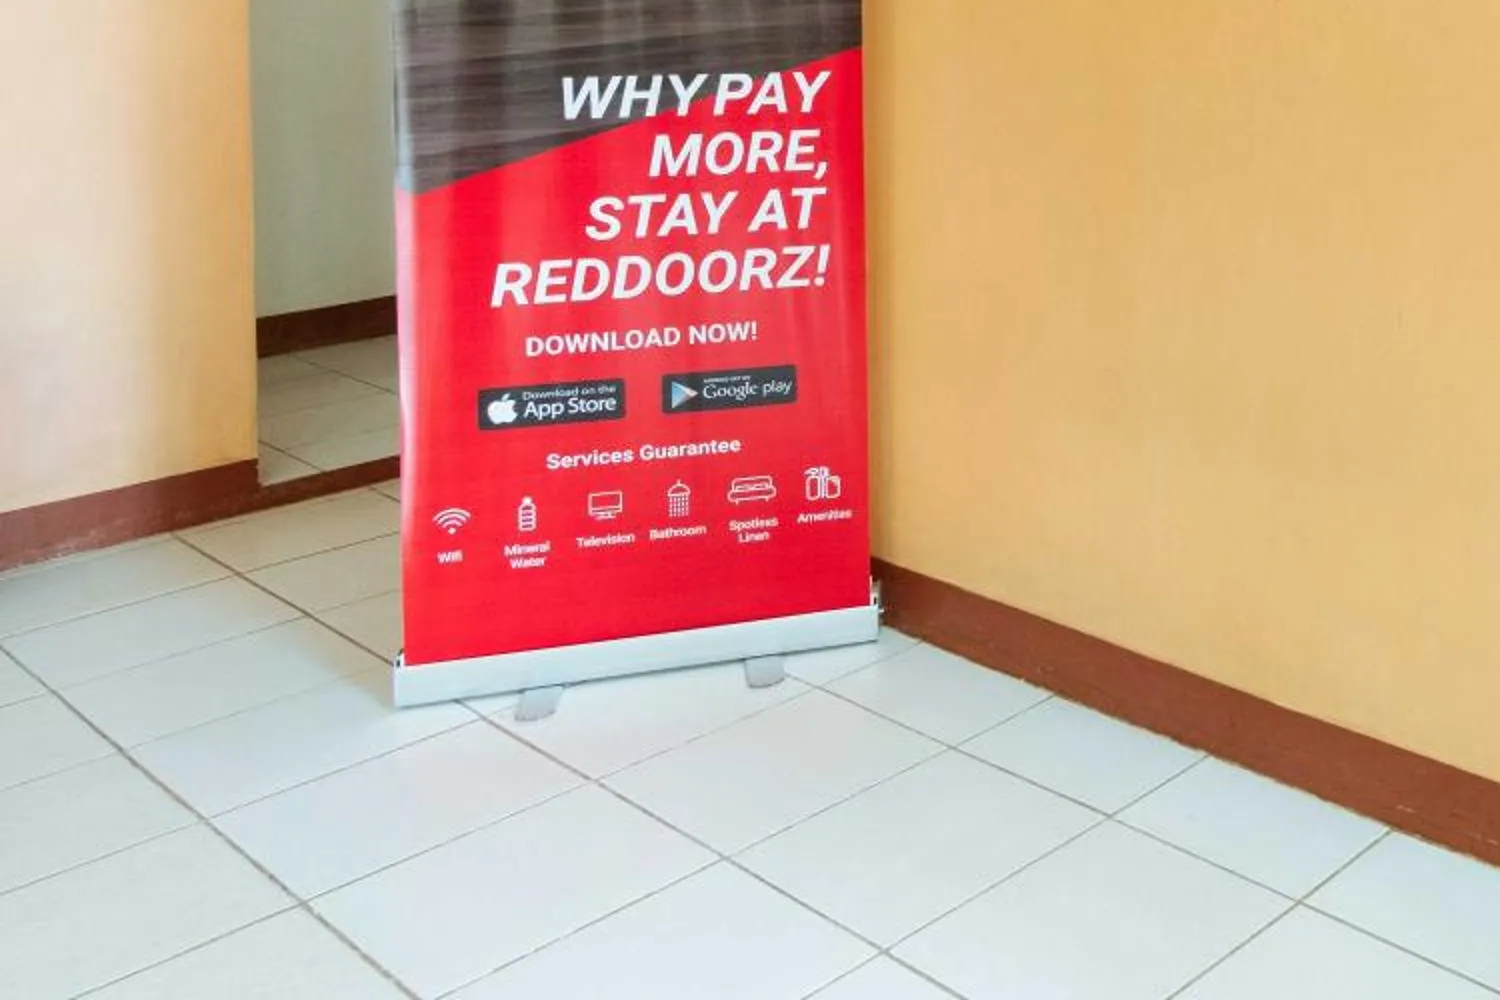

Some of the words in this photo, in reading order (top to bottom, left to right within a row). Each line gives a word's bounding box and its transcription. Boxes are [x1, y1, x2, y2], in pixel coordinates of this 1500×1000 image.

[561, 73, 708, 120] WHY
[713, 70, 831, 116] PAY
[648, 129, 828, 179] MORE,
[585, 190, 739, 241] STAY
[747, 187, 827, 232] AT
[490, 244, 830, 309] REDDOORZ!
[525, 327, 681, 358] DOWNLOAD
[689, 321, 758, 346] NOW!
[522, 387, 579, 401] Download
[703, 382, 758, 401] Google
[763, 380, 792, 397] play
[523, 401, 565, 420] App
[567, 397, 617, 414] Store
[546, 451, 634, 470] Services
[640, 439, 743, 461] Guarantee
[729, 517, 779, 532] Spotless
[797, 509, 853, 525] Amenities
[576, 533, 635, 548] Television
[649, 525, 707, 541] Bathroom
[738, 531, 770, 544] Linen
[504, 541, 551, 557] Mineral
[510, 557, 545, 569] Water
